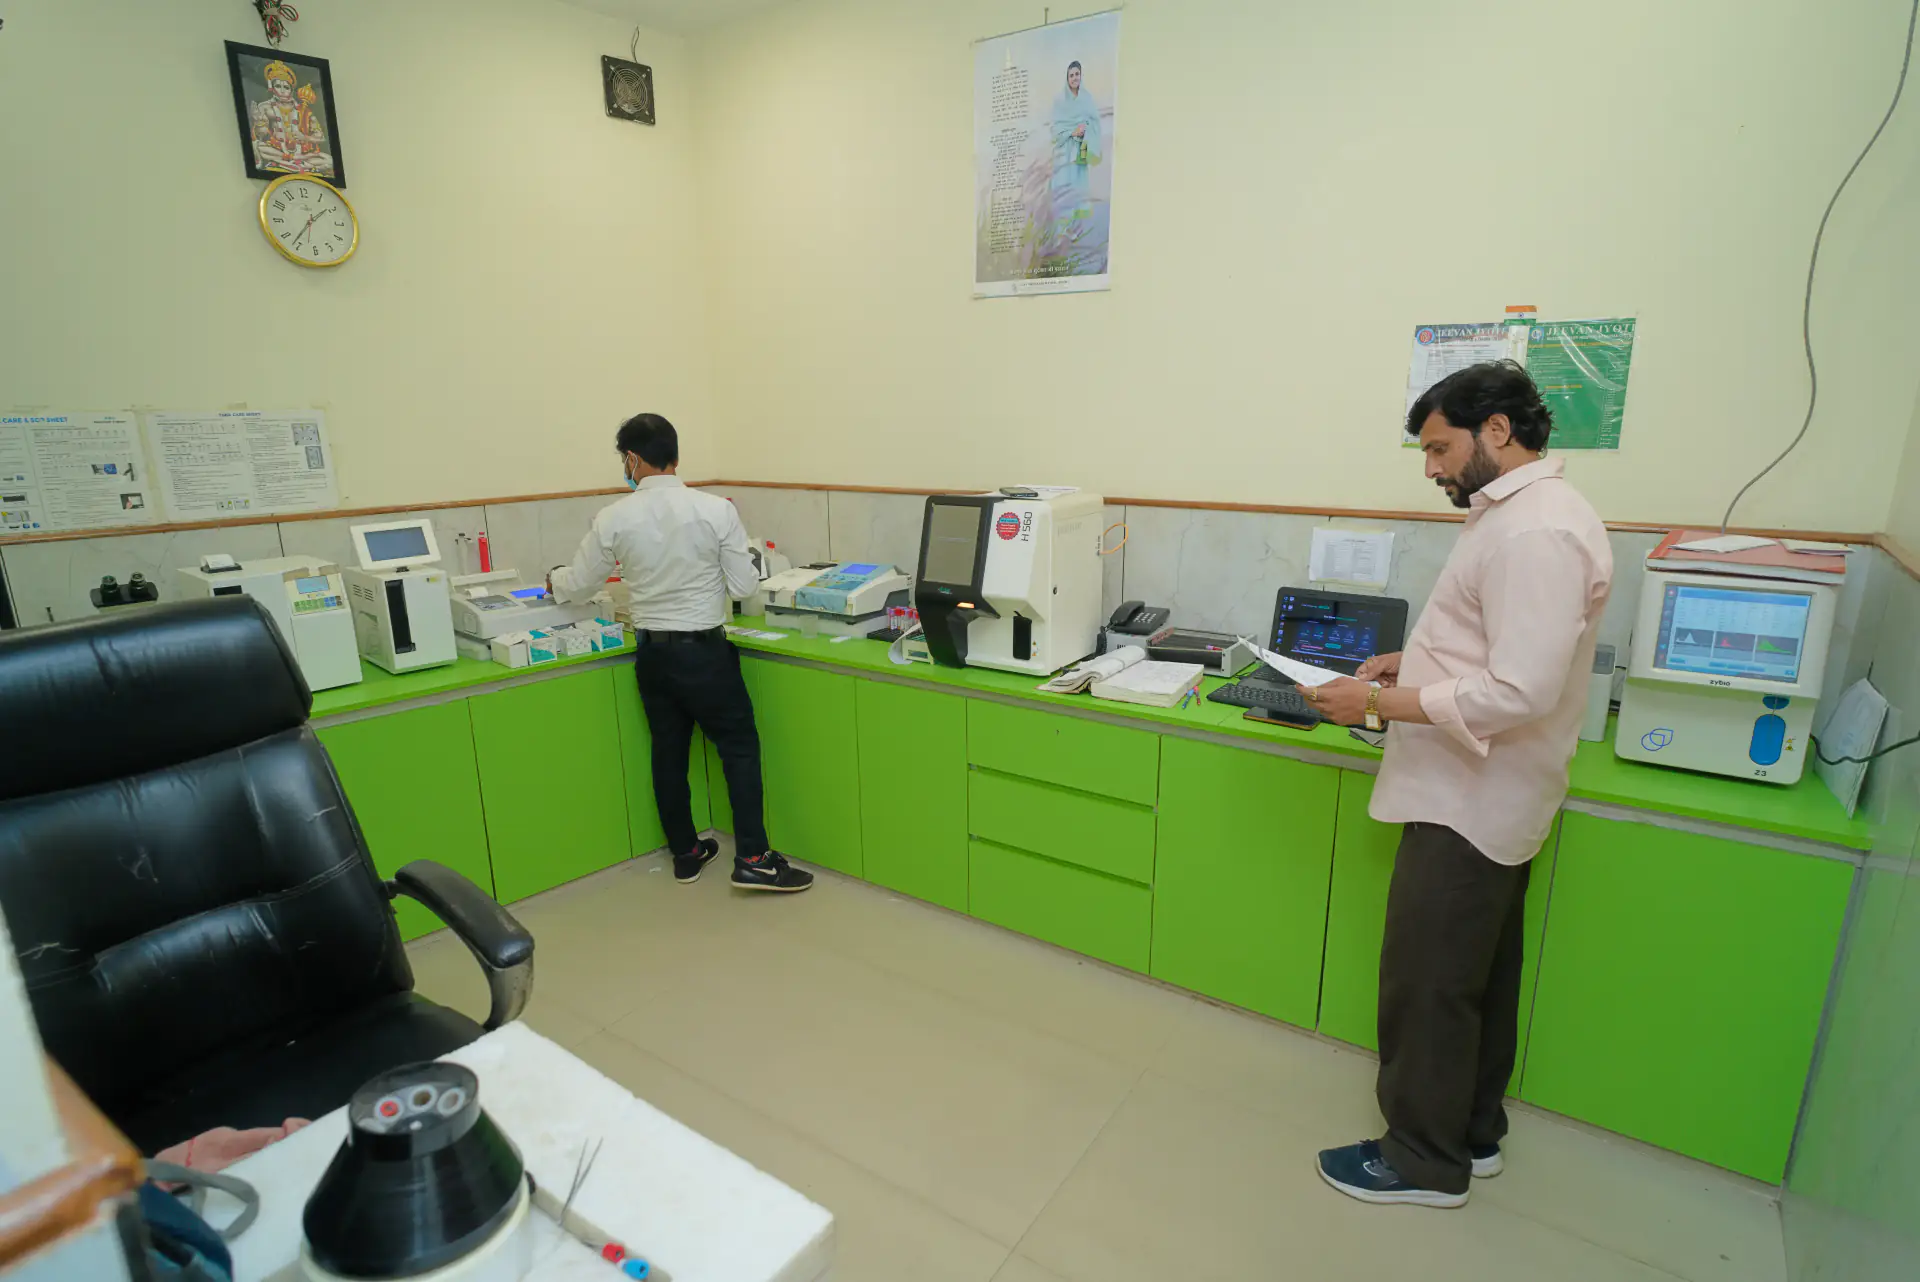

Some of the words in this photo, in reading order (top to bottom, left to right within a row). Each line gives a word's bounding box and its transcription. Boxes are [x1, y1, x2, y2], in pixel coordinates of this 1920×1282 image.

[283, 190, 294, 201] 11
[299, 188, 308, 198] 12
[318, 193, 322, 202] 1
[273, 200, 286, 211] 10
[296, 242, 303, 251] 7
[313, 246, 318, 256] 6
[325, 242, 333, 252] 5
[1436, 328, 1472, 336] JEEVAN
[1546, 326, 1592, 335] JEEVAN
[1597, 324, 1635, 333] JYOTI
